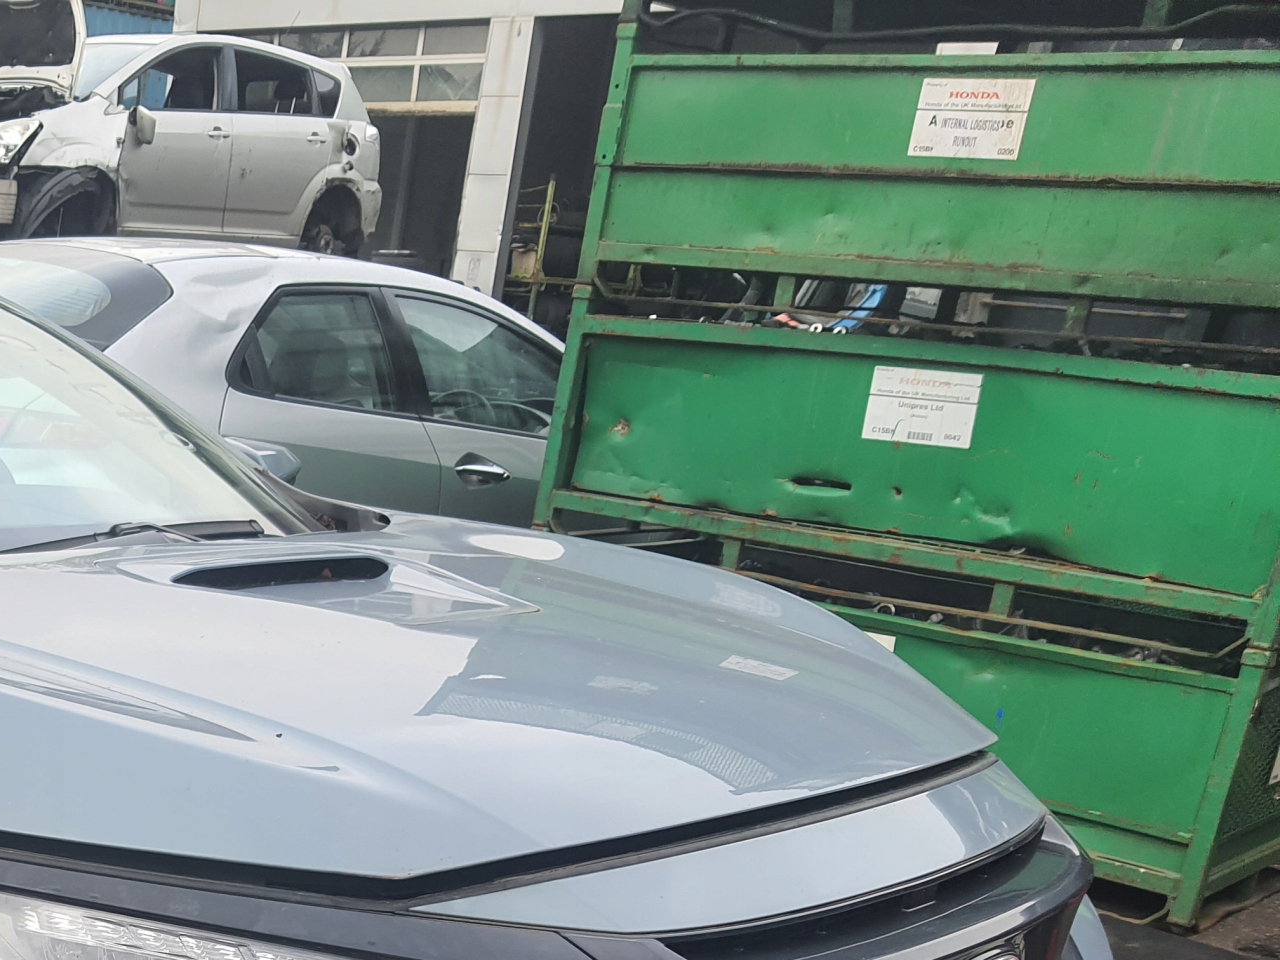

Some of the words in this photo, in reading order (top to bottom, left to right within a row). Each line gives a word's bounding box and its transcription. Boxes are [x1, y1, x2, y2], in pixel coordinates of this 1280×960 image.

[949, 91, 1000, 100] HONDA
[940, 117, 968, 130] INTERNAL
[970, 118, 1001, 132] LOGISTICS
[952, 136, 978, 148] RUNOUT
[899, 377, 953, 389] HONDA
[930, 403, 945, 412] Ltd
